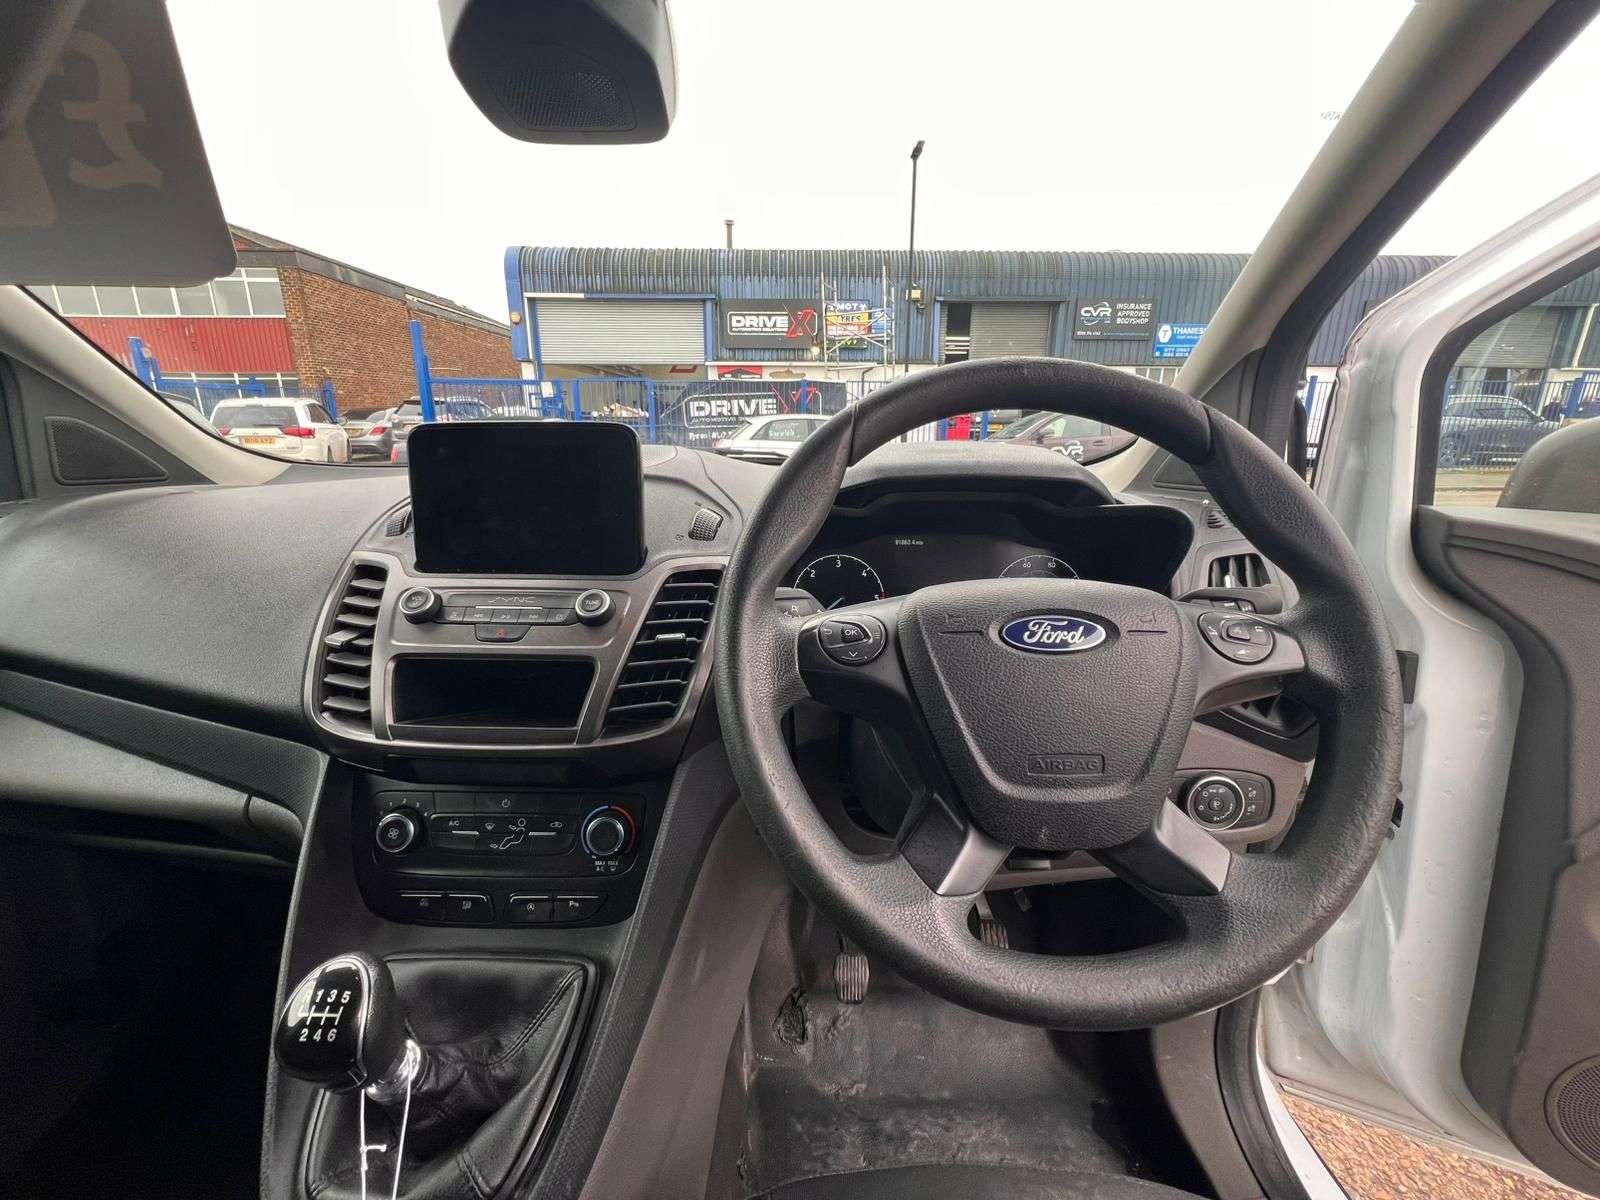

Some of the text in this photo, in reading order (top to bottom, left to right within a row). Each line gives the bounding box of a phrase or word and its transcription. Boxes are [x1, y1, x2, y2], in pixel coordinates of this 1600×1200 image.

[1080, 306, 1112, 317] CVR
[731, 315, 789, 328] DRIVE
[836, 314, 862, 322] YRES
[1116, 317, 1149, 325] BODYSHOP
[688, 398, 777, 417] DRIVE
[835, 559, 842, 568] 3
[810, 569, 816, 578] 2
[861, 568, 868, 577] 4
[1022, 619, 1085, 645] Ford
[1036, 758, 1099, 771] AIRBAG
[315, 989, 324, 1002] 1
[327, 989, 337, 1003] 3
[340, 990, 351, 1003] 5
[298, 1028, 337, 1042] 2 4 6
